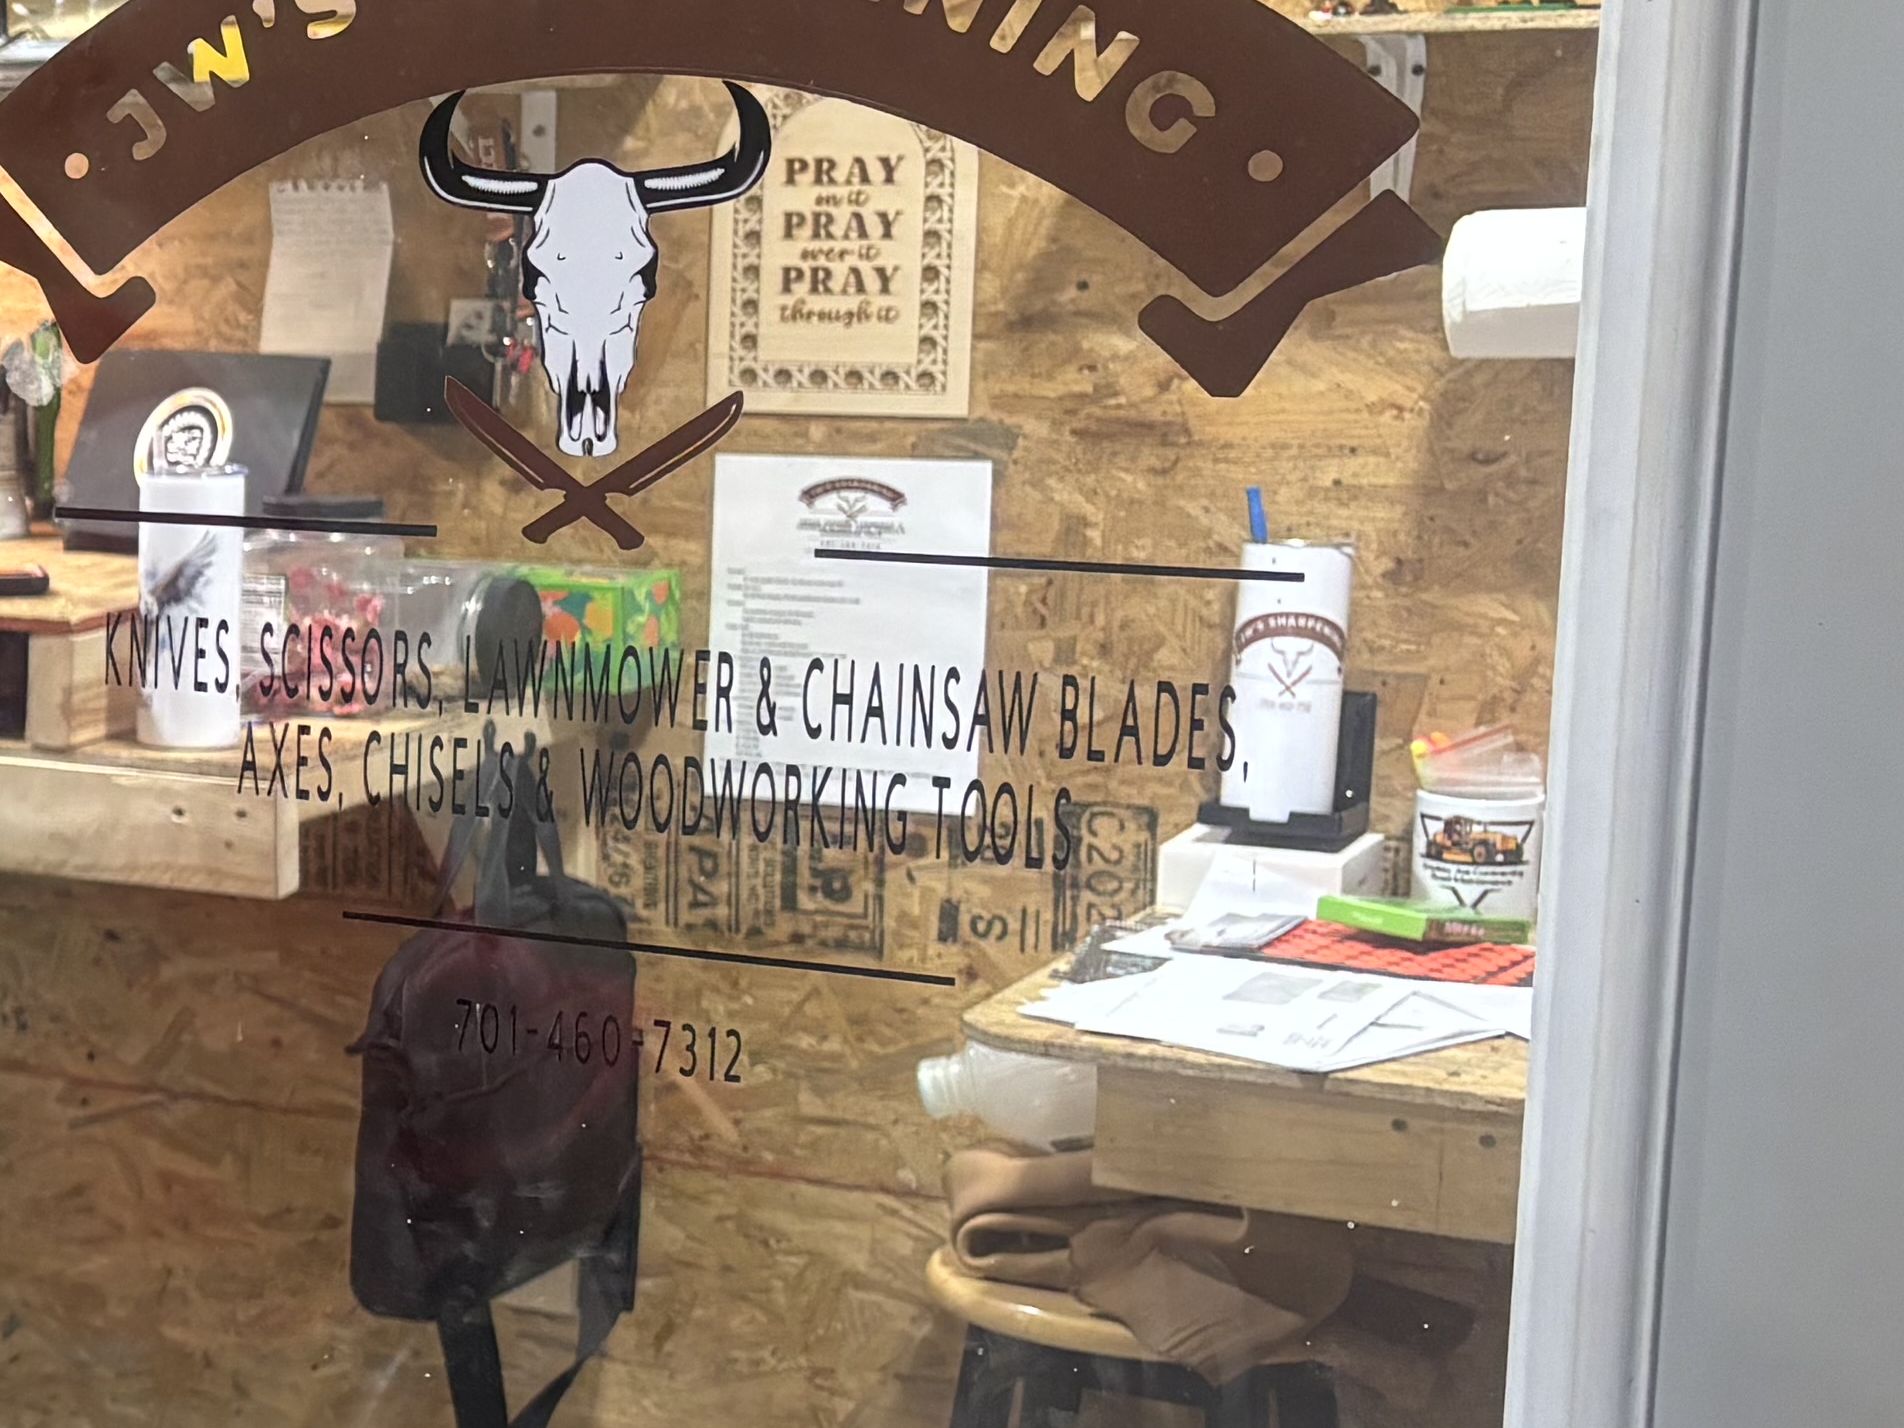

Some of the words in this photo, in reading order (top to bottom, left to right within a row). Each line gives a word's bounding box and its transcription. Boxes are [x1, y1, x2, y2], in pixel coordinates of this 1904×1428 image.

[784, 155, 905, 187] PRAY
[815, 191, 842, 208] on
[848, 190, 871, 207] it
[783, 210, 904, 241] PRAY
[800, 247, 855, 263] over
[856, 244, 881, 260] it
[781, 266, 901, 296] PRAY
[779, 299, 873, 329] through
[875, 308, 900, 324] it
[104, 612, 241, 702] KNIVES,
[259, 622, 443, 717] SCISSORS,
[464, 635, 735, 735] LAWNMOWER
[757, 658, 778, 737] &
[802, 658, 1037, 756] CHAINSAW
[1059, 674, 1249, 783] BLADES,
[238, 723, 344, 811] AXES,
[364, 733, 515, 819] CHISELS
[535, 750, 556, 825] &
[579, 747, 909, 856] WOODWORKING
[932, 776, 1072, 872] TOOLS
[1085, 811, 1125, 923] C202
[455, 998, 744, 1086] 701-460-7312
